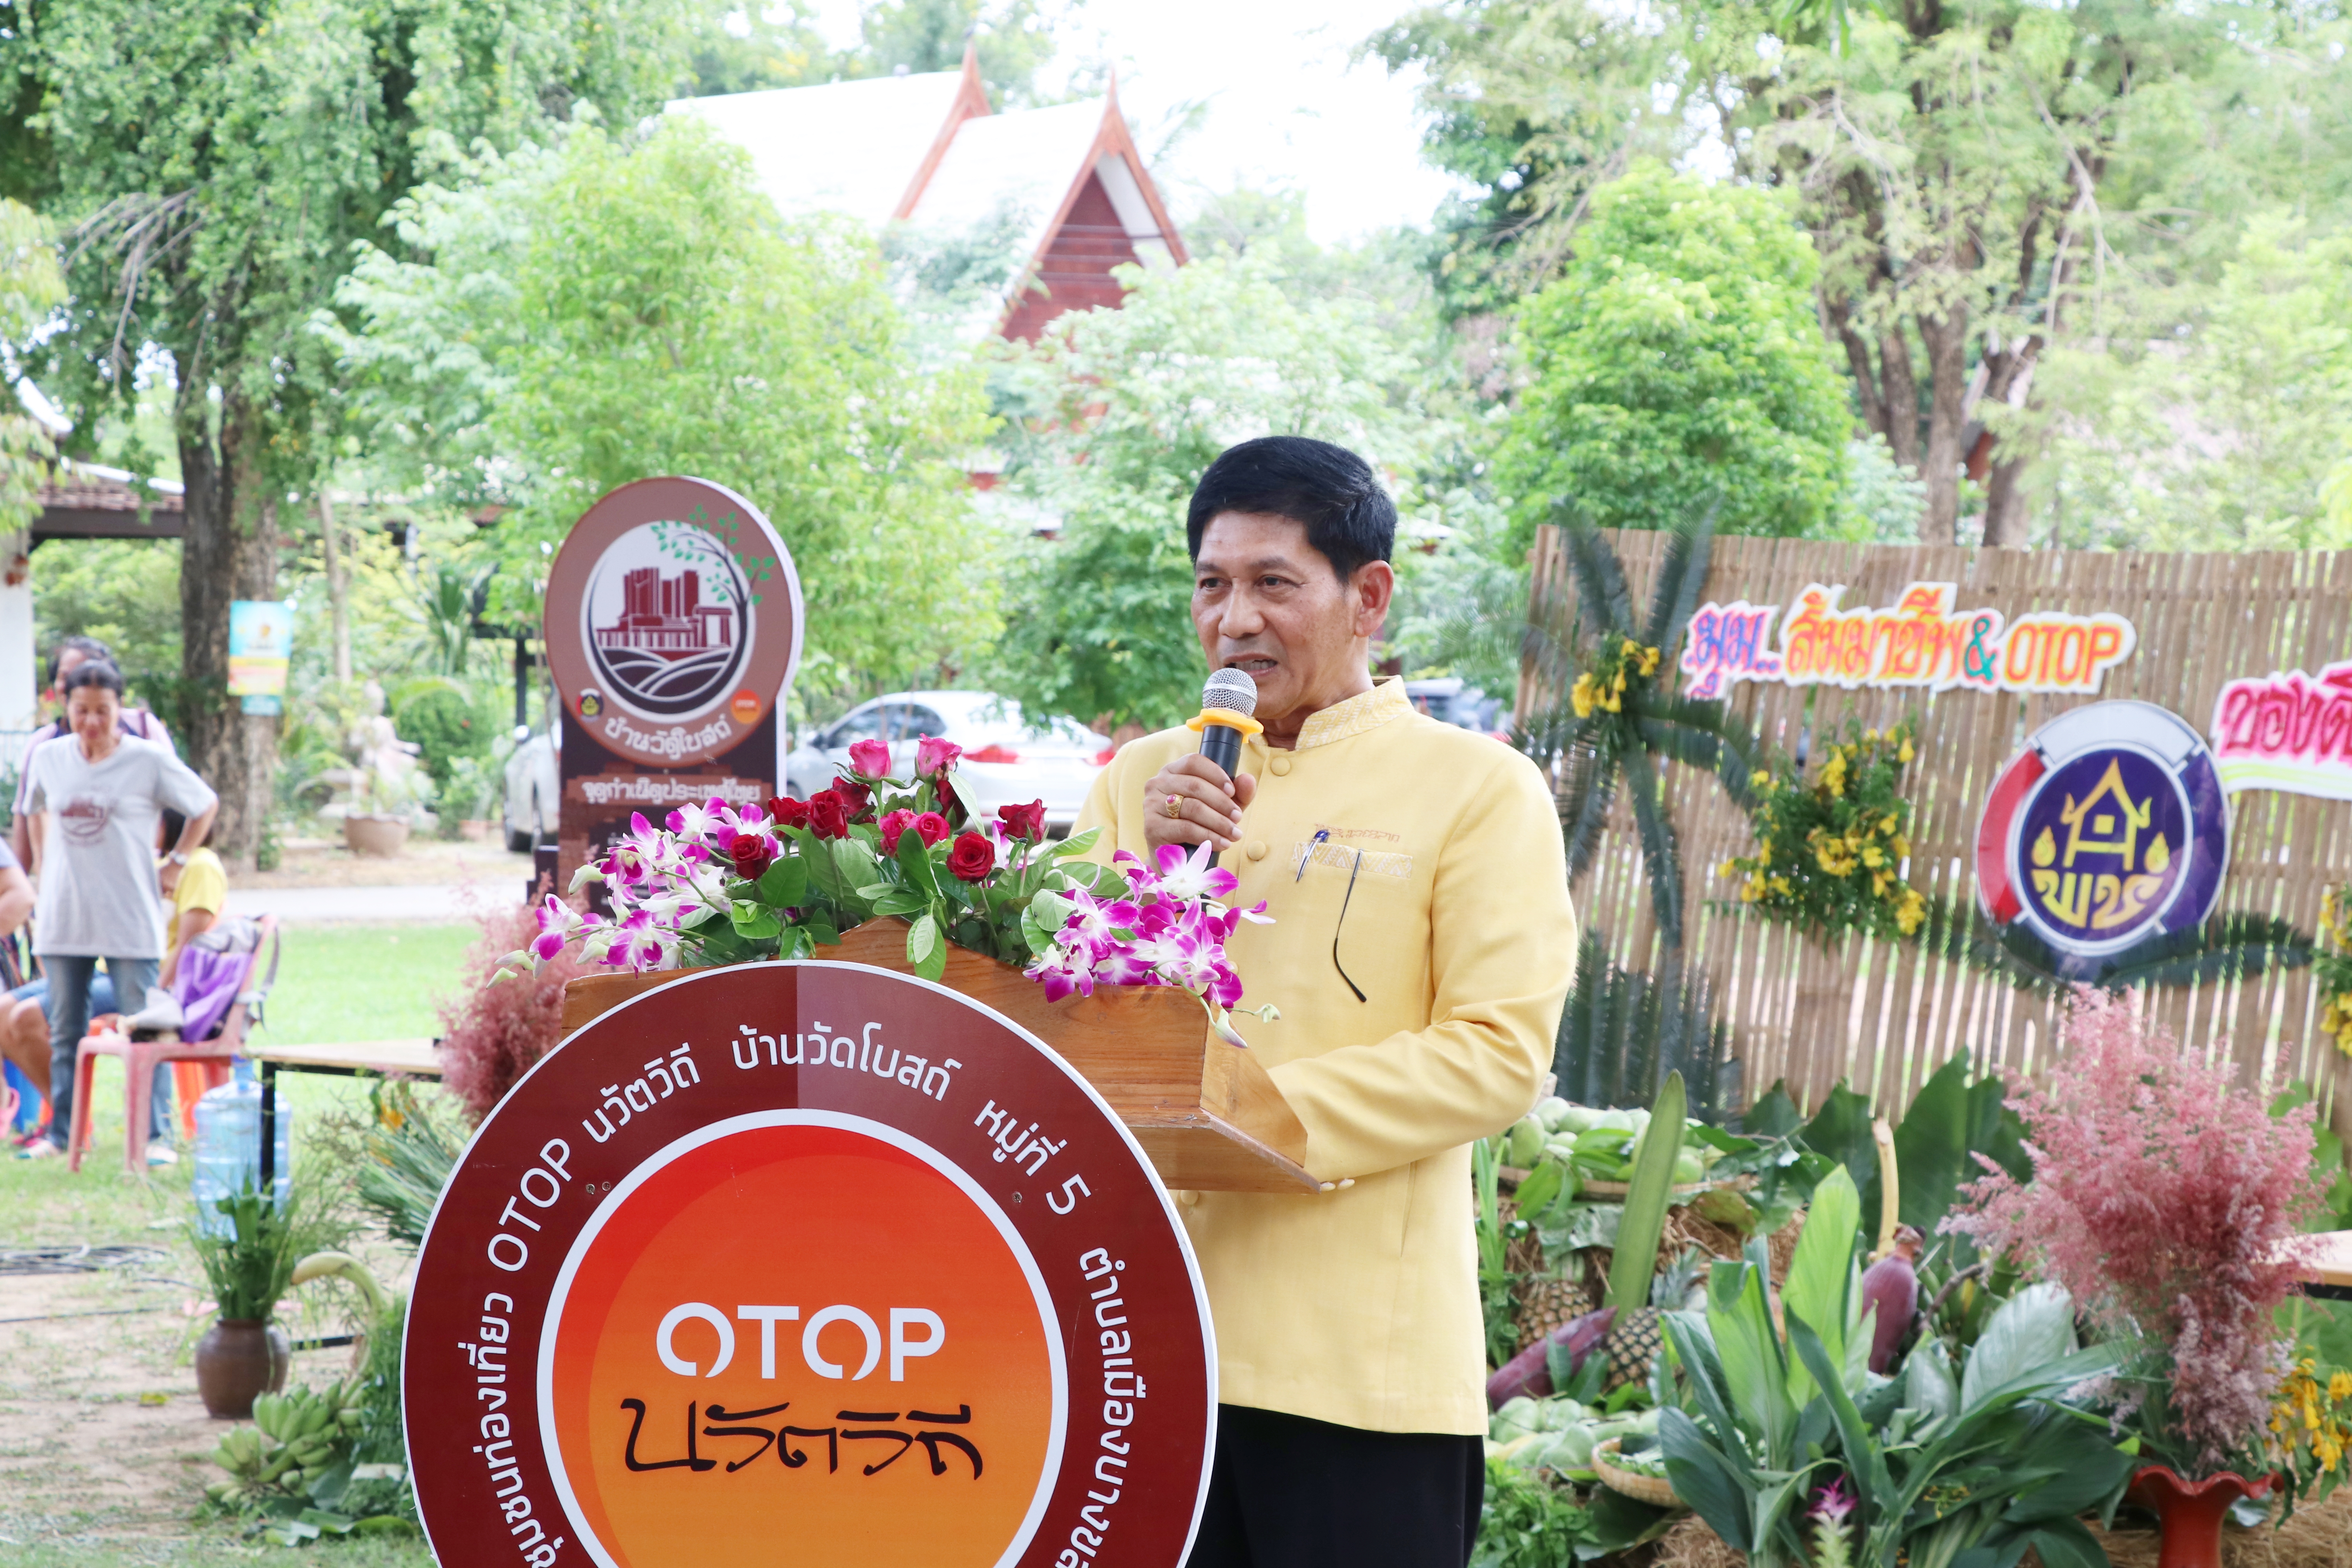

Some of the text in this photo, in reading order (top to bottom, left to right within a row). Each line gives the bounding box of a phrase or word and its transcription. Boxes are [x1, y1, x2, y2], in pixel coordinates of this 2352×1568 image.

[488, 1138, 572, 1271] OTOP
[582, 1042, 700, 1143] นวัตวิถี
[732, 1021, 962, 1101] บ้านวัดโบสถ์
[974, 1100, 1068, 1176] หมู่ที่
[1046, 1174, 1091, 1214] 5
[656, 1302, 945, 1382] OTOP
[621, 1398, 983, 1480] นวัตวิถี
